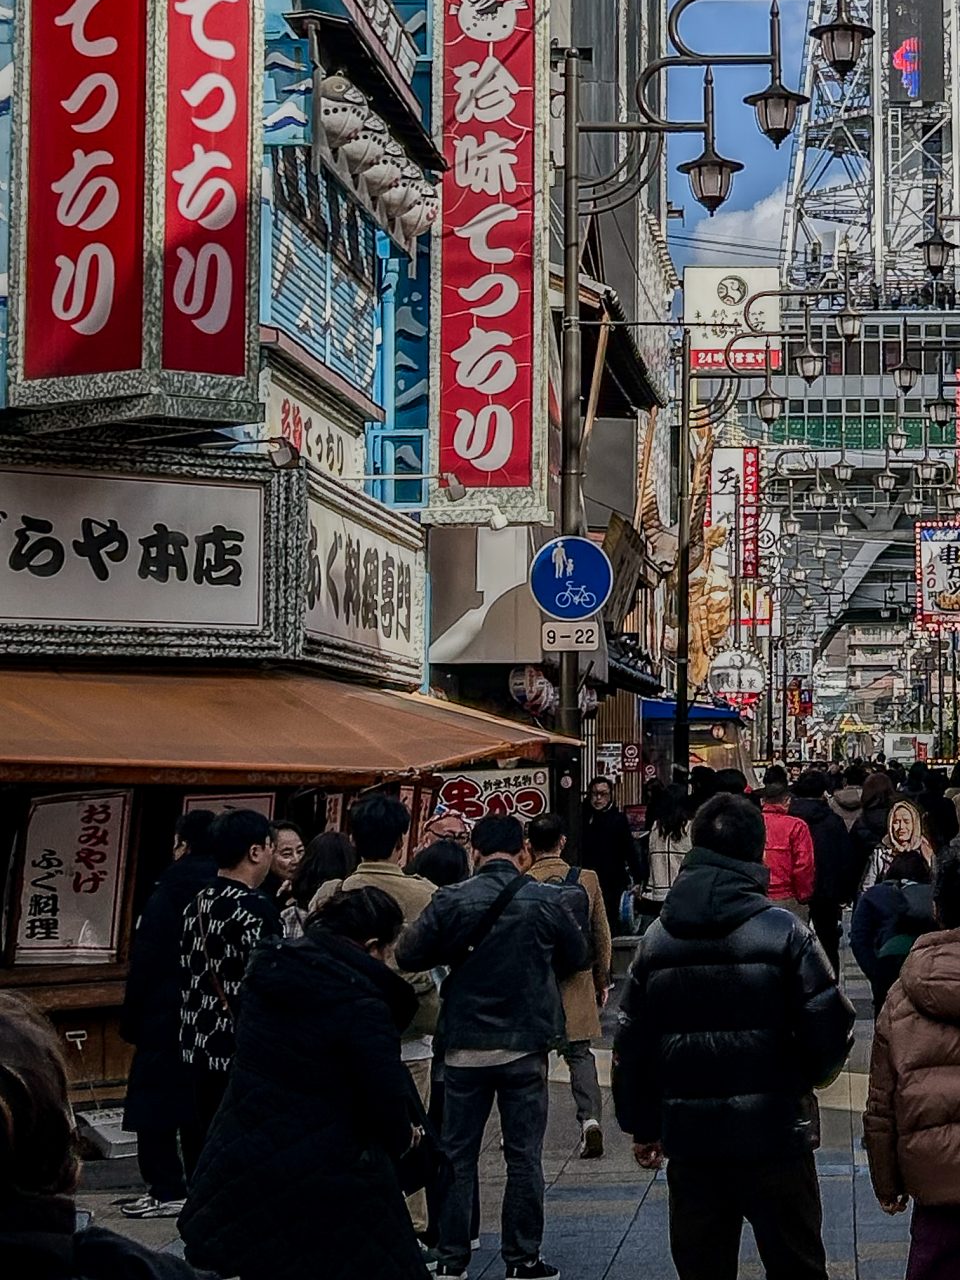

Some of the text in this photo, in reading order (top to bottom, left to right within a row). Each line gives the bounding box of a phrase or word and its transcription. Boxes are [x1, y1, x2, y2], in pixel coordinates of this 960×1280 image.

[450, 55, 520, 473] 珍味てっちり
[0, 512, 246, 588] らや本店
[546, 626, 596, 646] 9-22
[440, 776, 546, 819] 串かつ
[72, 803, 112, 894] おみやげ
[25, 847, 64, 941] ふぐ料理
[201, 898, 214, 914] NY
[221, 885, 248, 899] NY
[231, 906, 257, 926] NY
[208, 1056, 231, 1071] NY
